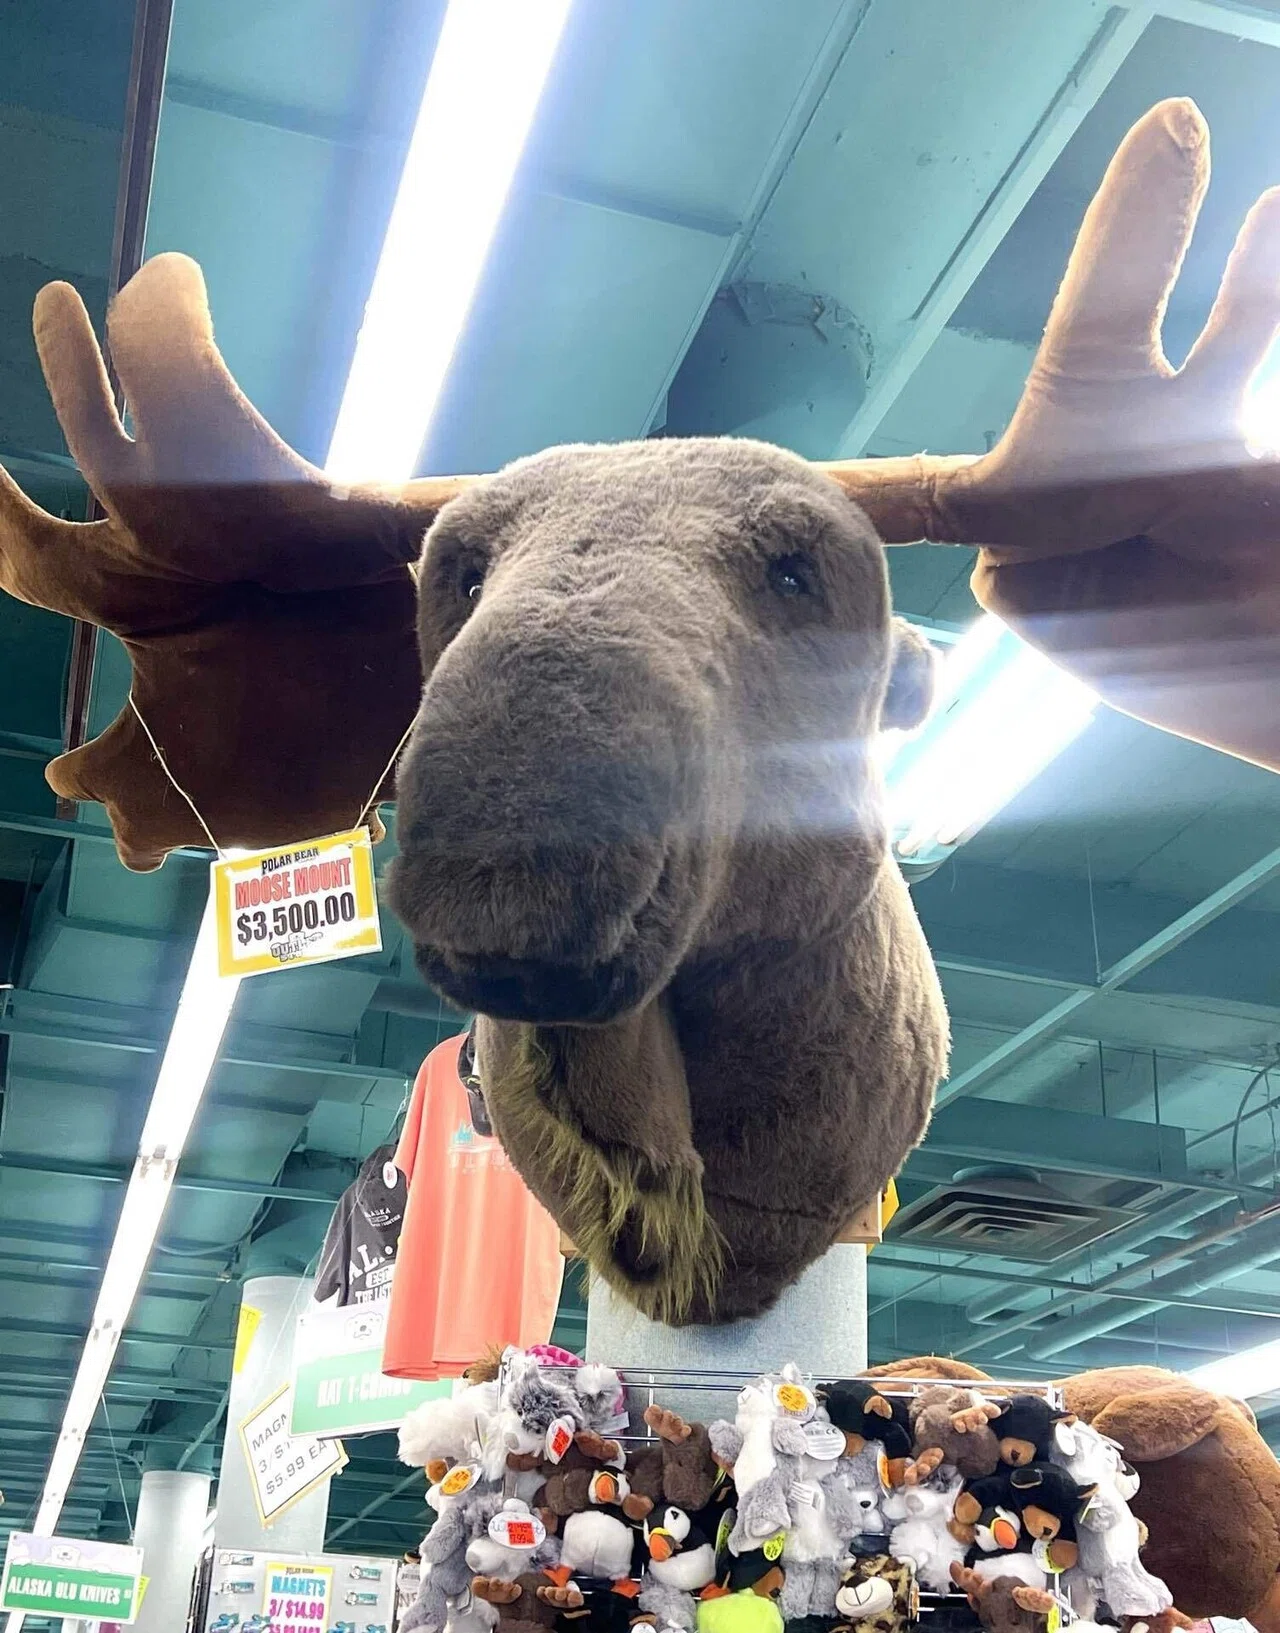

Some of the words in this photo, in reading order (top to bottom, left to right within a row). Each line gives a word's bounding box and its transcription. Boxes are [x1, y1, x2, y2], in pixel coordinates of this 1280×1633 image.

[261, 853, 292, 875] POLAR
[294, 846, 320, 861] BEAR
[235, 870, 292, 910] MOOSE
[294, 857, 351, 897] MOUNT
[237, 892, 355, 946] $3,500.00
[266, 1456, 305, 1495] $5.99
[7, 1576, 53, 1598] ALASKA
[55, 1581, 78, 1600] ULU
[79, 1583, 121, 1605] KNIVES
[271, 1575, 326, 1598] MAGNETS
[285, 1600, 325, 1620] $14.99
